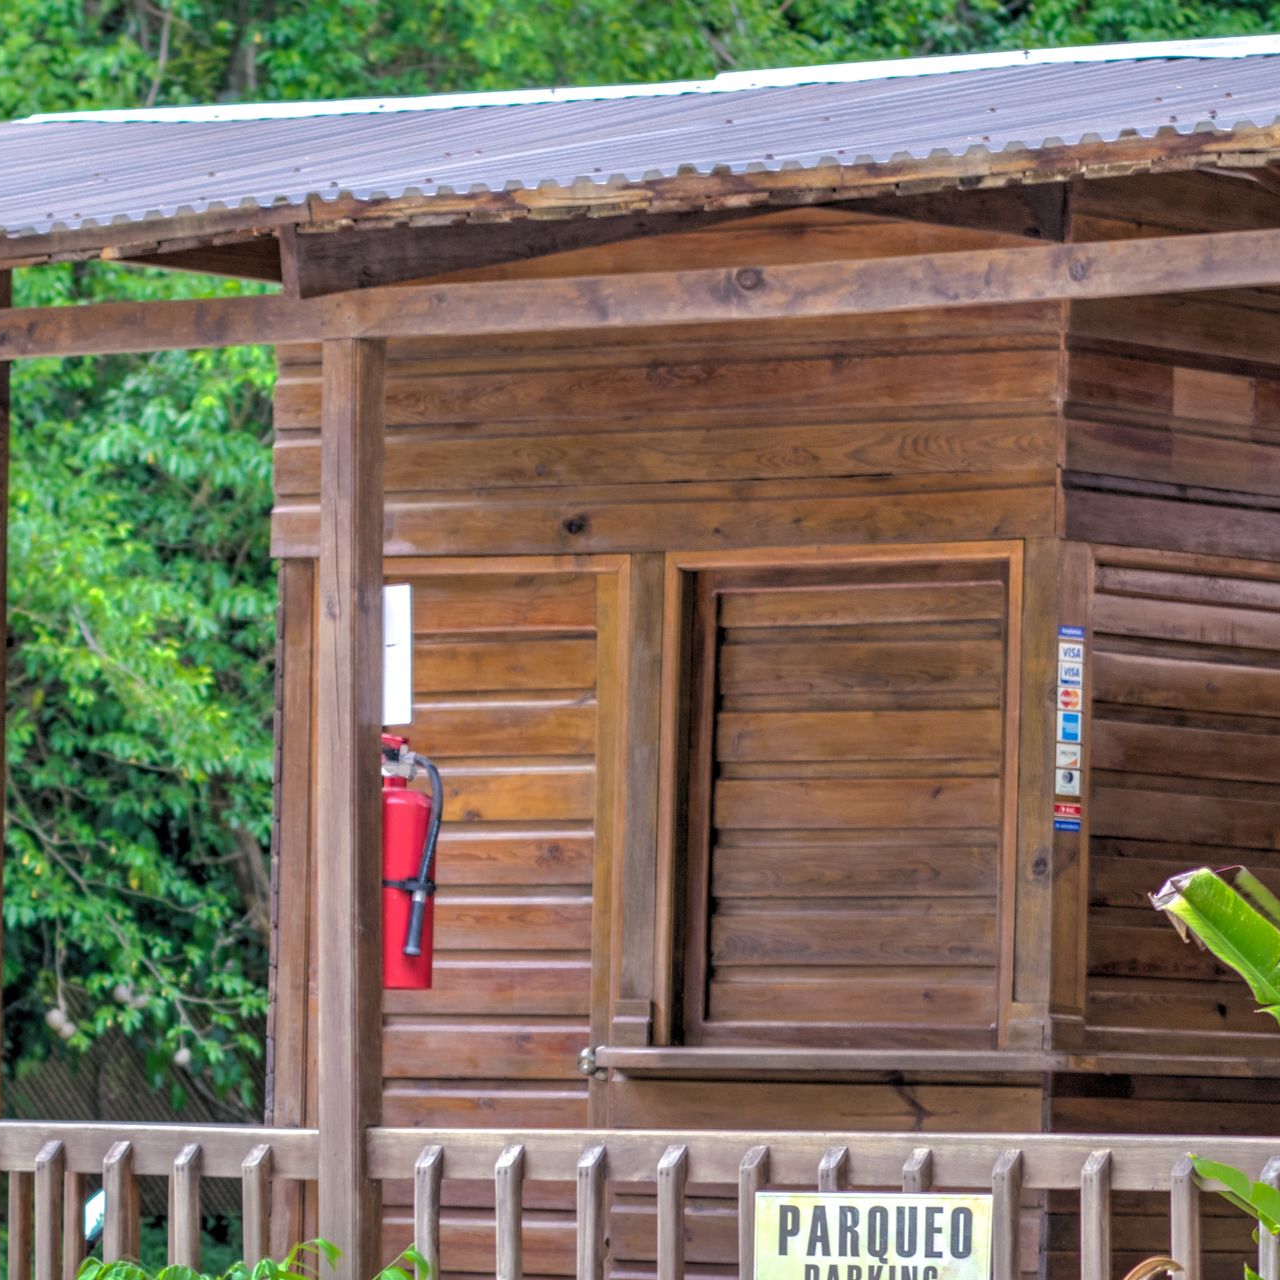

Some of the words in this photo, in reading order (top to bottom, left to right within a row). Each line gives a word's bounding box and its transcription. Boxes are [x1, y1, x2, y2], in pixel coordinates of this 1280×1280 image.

[1063, 647, 1081, 659] VISA
[1063, 667, 1080, 678] VISA
[778, 1204, 974, 1264] PARQUEO
